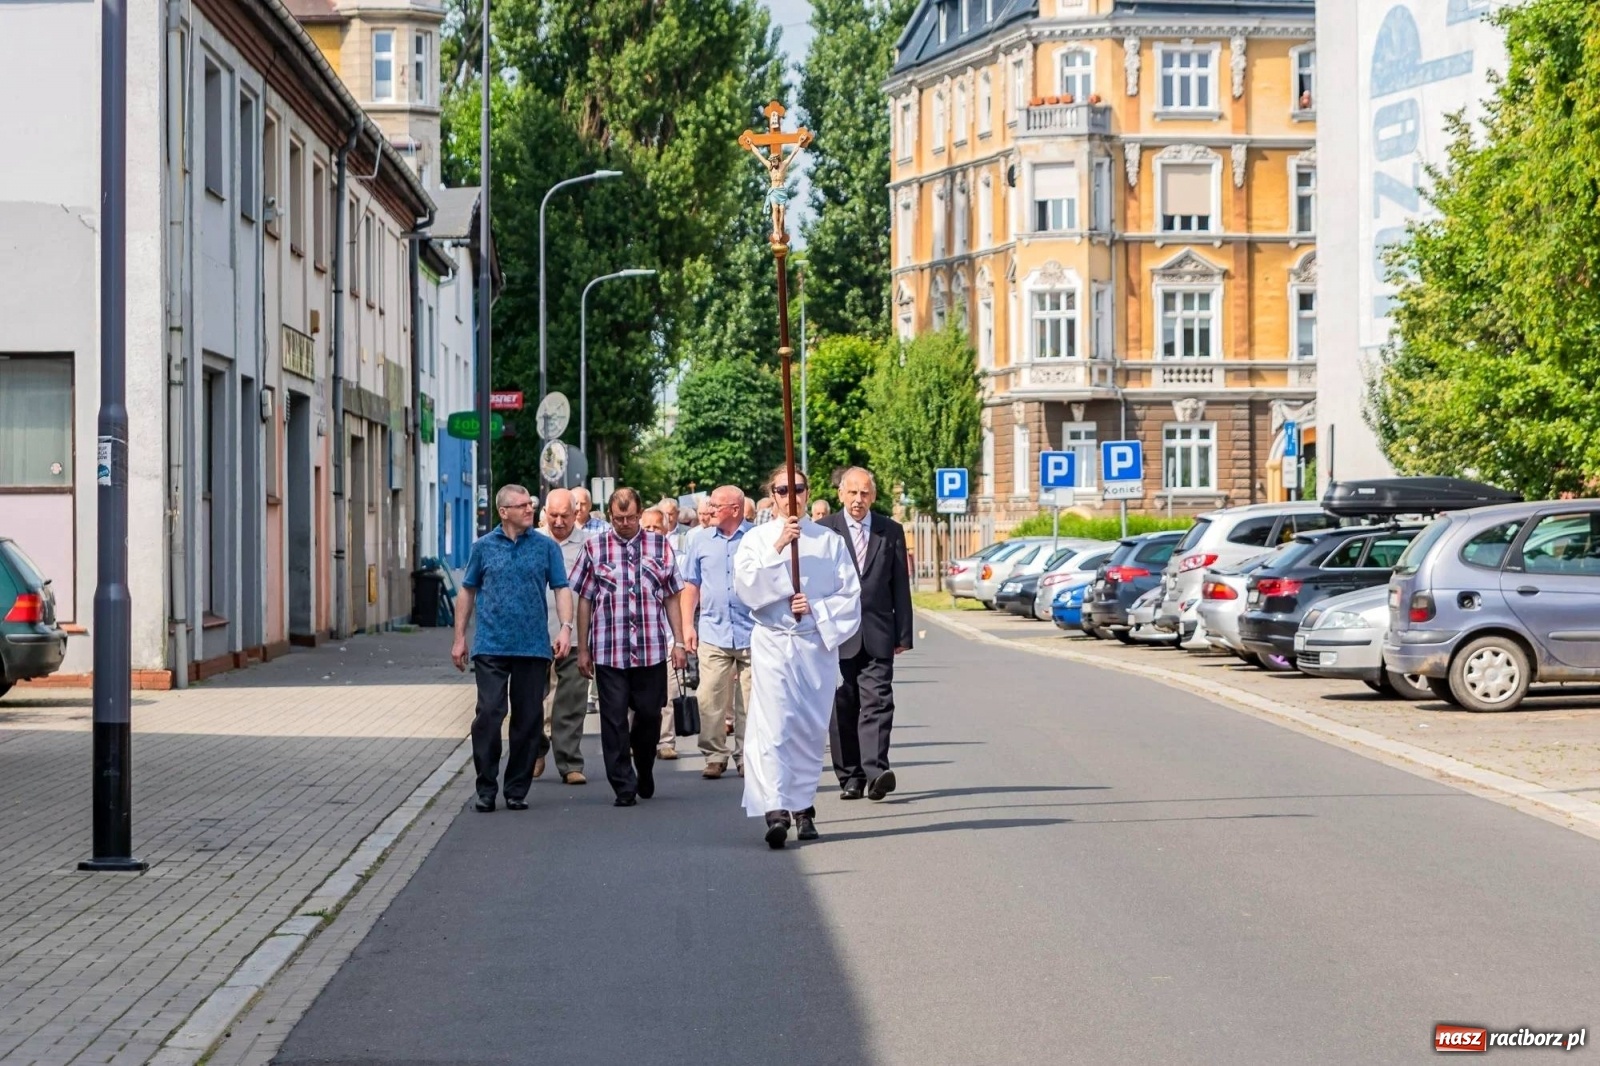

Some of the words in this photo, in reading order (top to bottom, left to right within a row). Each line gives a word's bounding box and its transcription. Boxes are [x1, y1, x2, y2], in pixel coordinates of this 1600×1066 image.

[453, 417, 498, 430] żaba
[1047, 455, 1069, 484] P
[1110, 446, 1134, 477] P
[943, 471, 962, 496] P
[1103, 485, 1142, 495] Koniec
